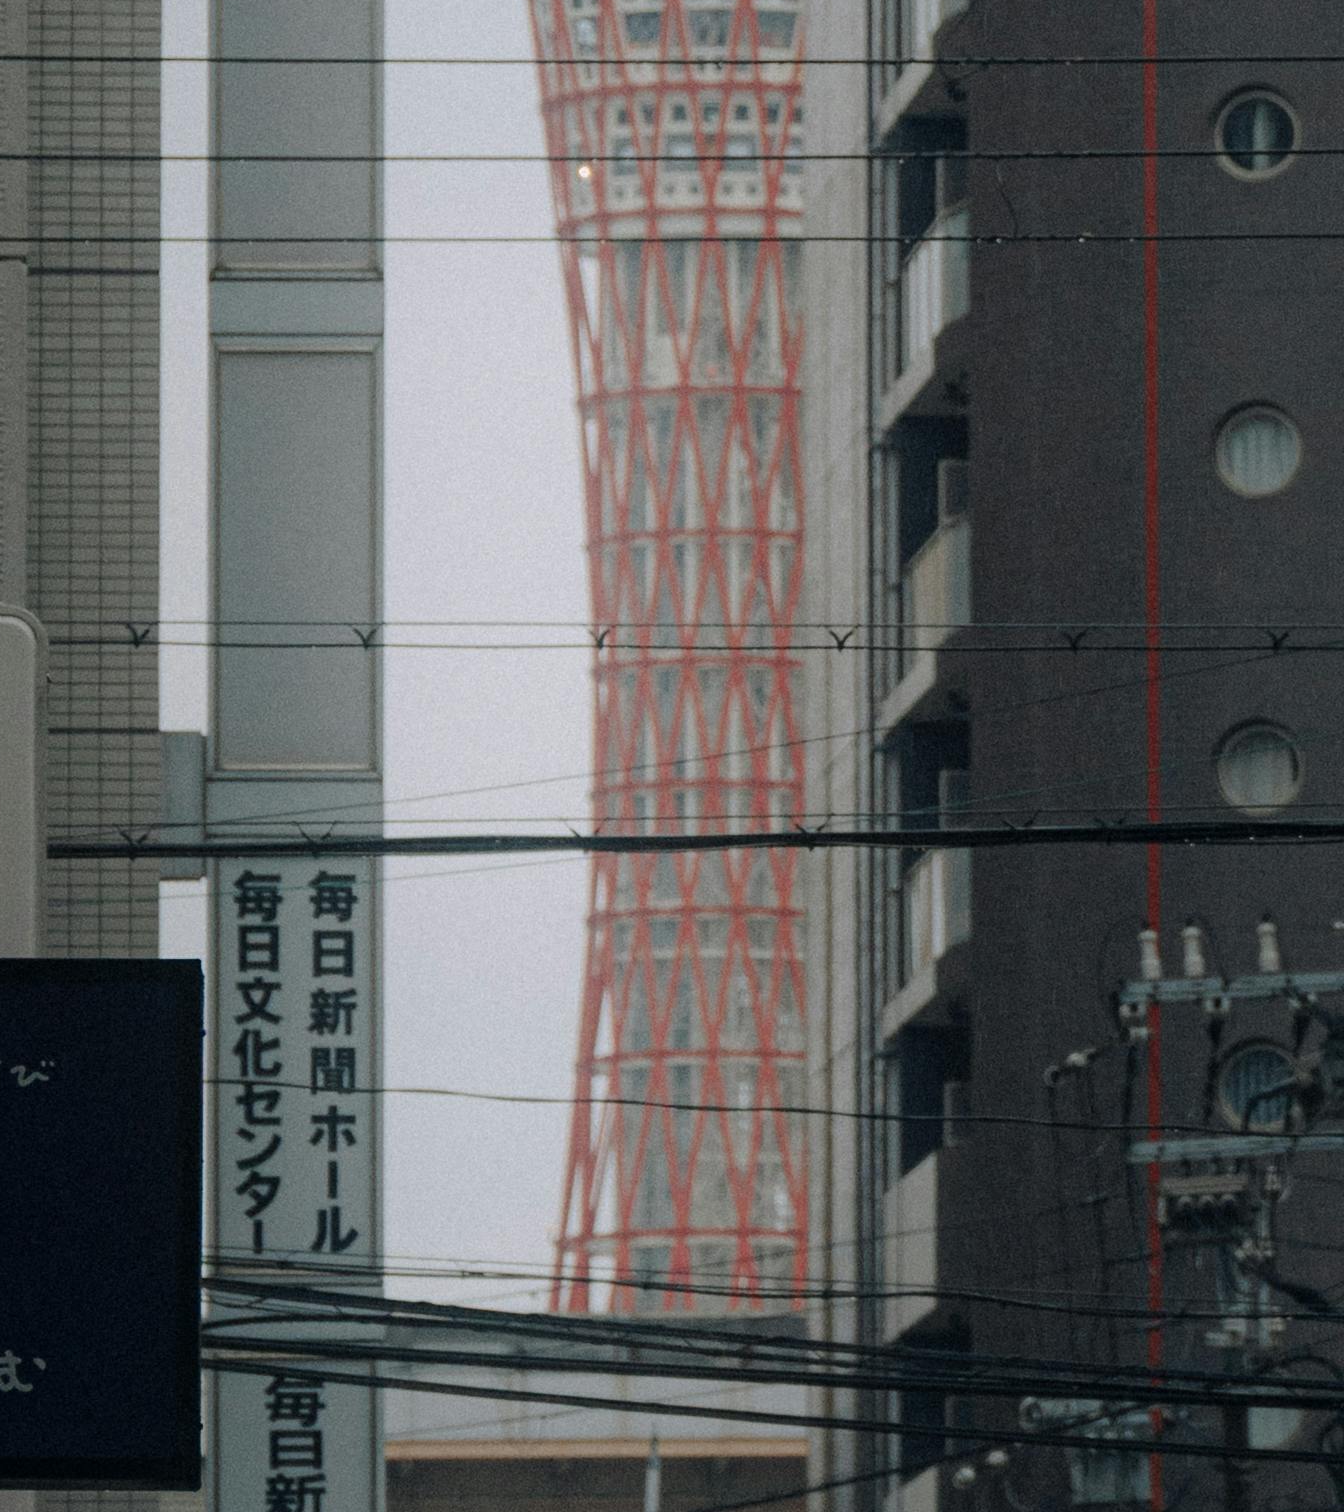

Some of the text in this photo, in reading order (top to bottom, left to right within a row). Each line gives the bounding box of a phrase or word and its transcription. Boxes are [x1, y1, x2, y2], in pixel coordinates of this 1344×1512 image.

[234, 870, 282, 1254] 毎日文化センター
[309, 870, 358, 1254] 毎日新聞ホール
